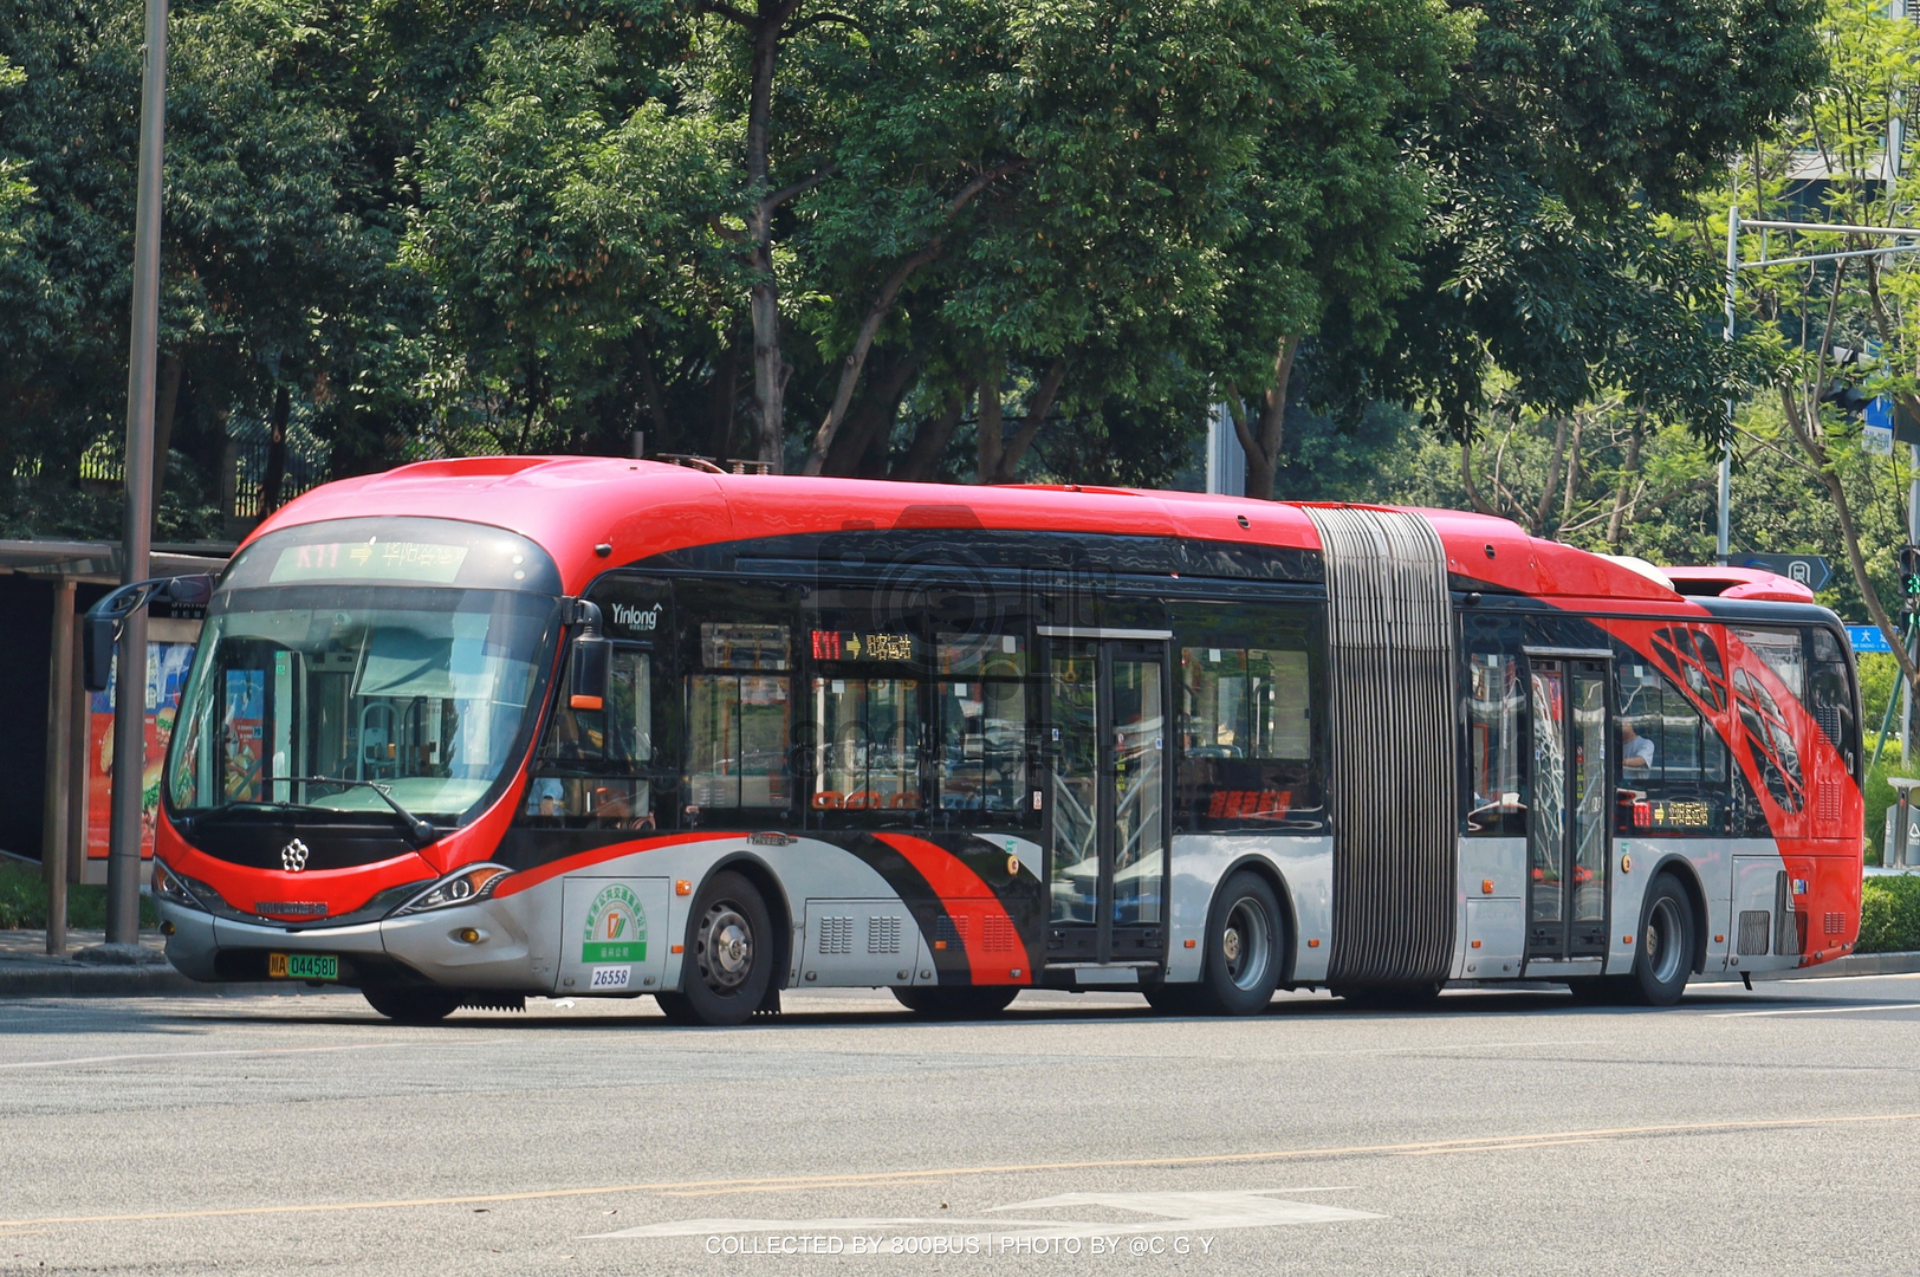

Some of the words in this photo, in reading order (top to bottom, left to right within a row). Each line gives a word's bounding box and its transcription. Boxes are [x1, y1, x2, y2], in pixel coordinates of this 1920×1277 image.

[297, 543, 340, 568] K11
[611, 602, 657, 630] Yinlong
[812, 630, 840, 660] K11
[593, 969, 628, 986] 26558
